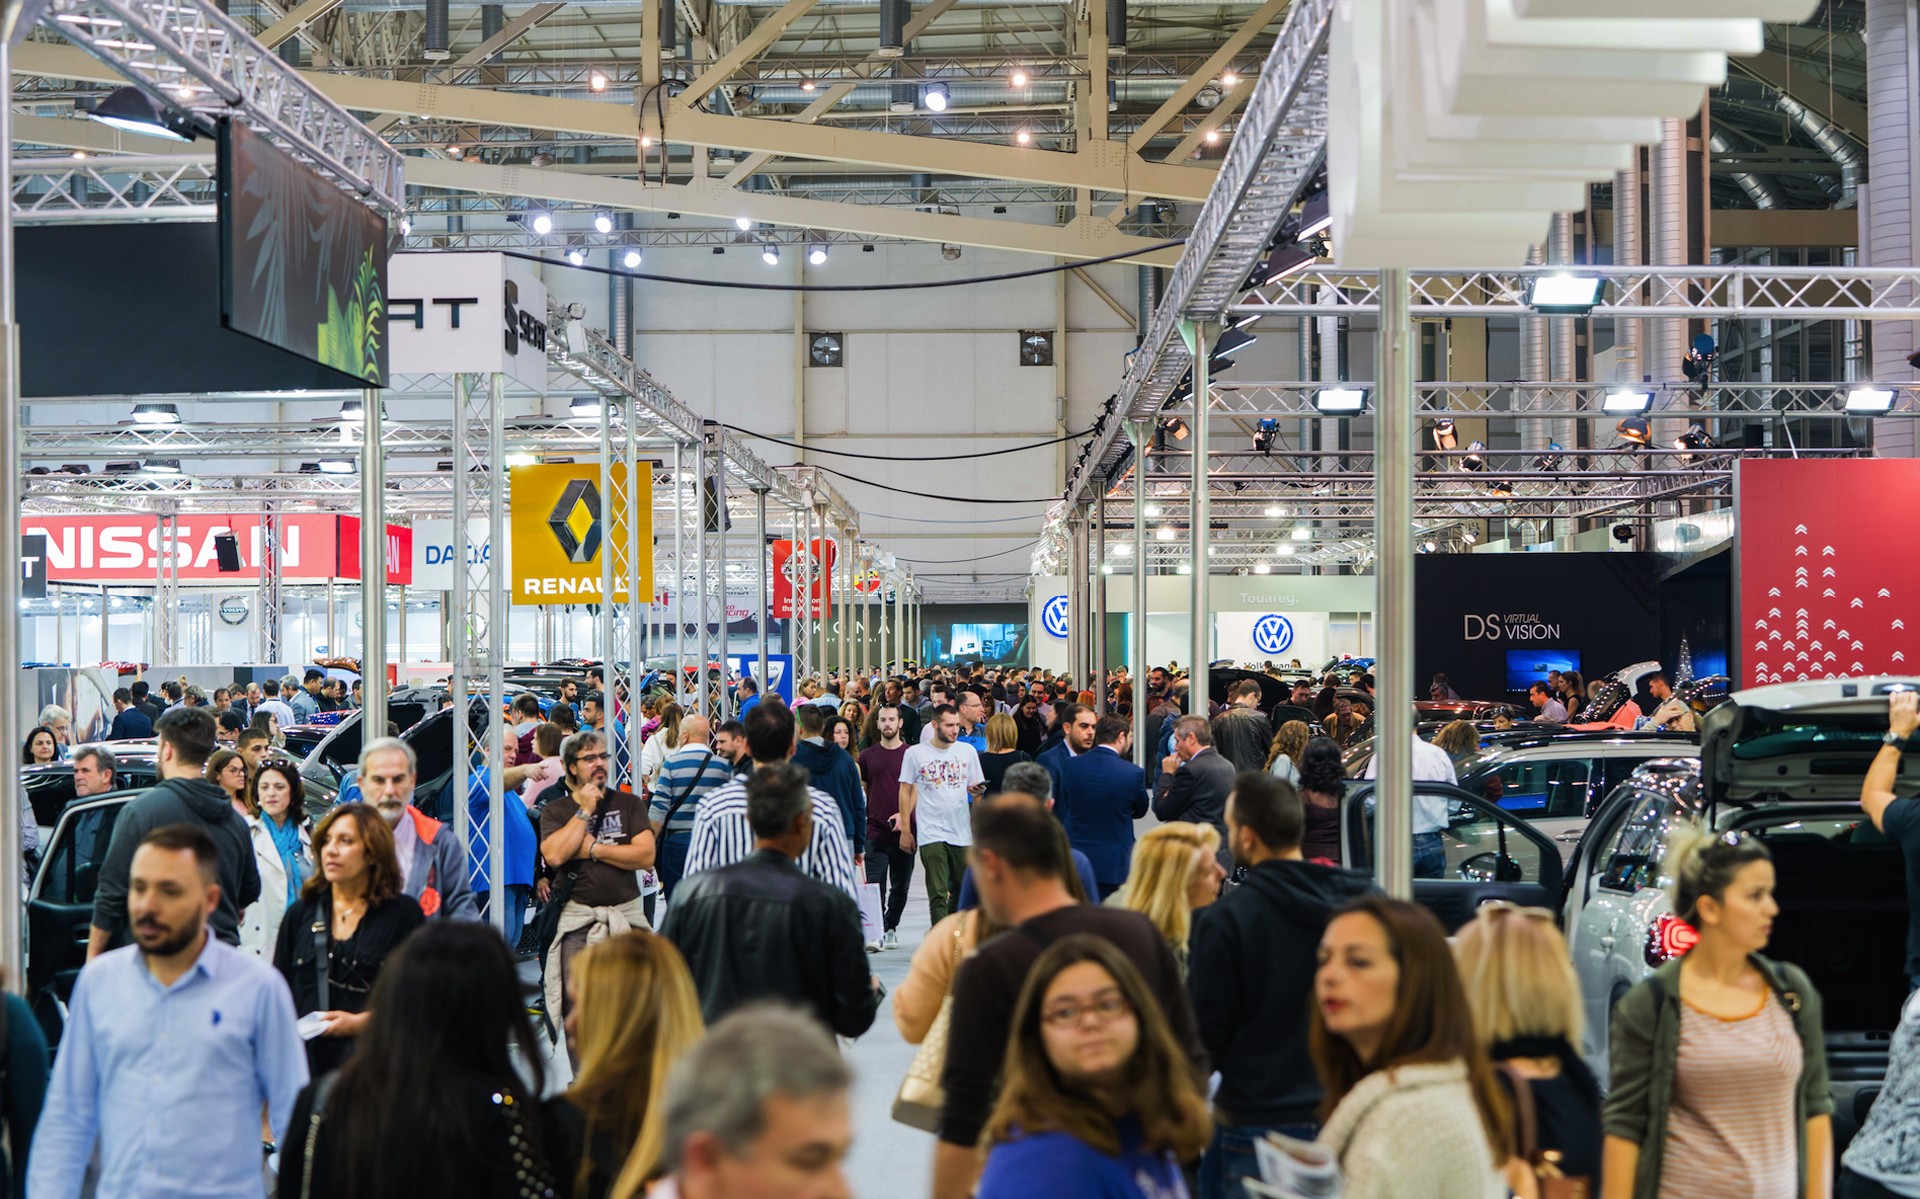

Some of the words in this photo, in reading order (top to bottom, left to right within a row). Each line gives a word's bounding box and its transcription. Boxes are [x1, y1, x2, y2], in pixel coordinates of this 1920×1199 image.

[519, 310, 547, 352] SEAT
[26, 525, 299, 568] NISSAN
[524, 576, 642, 595] RENAL
[1240, 592, 1299, 606] Touareg.
[1464, 613, 1500, 640] DS
[1503, 613, 1540, 623] VIRTUAL
[1505, 624, 1560, 639] VISION
